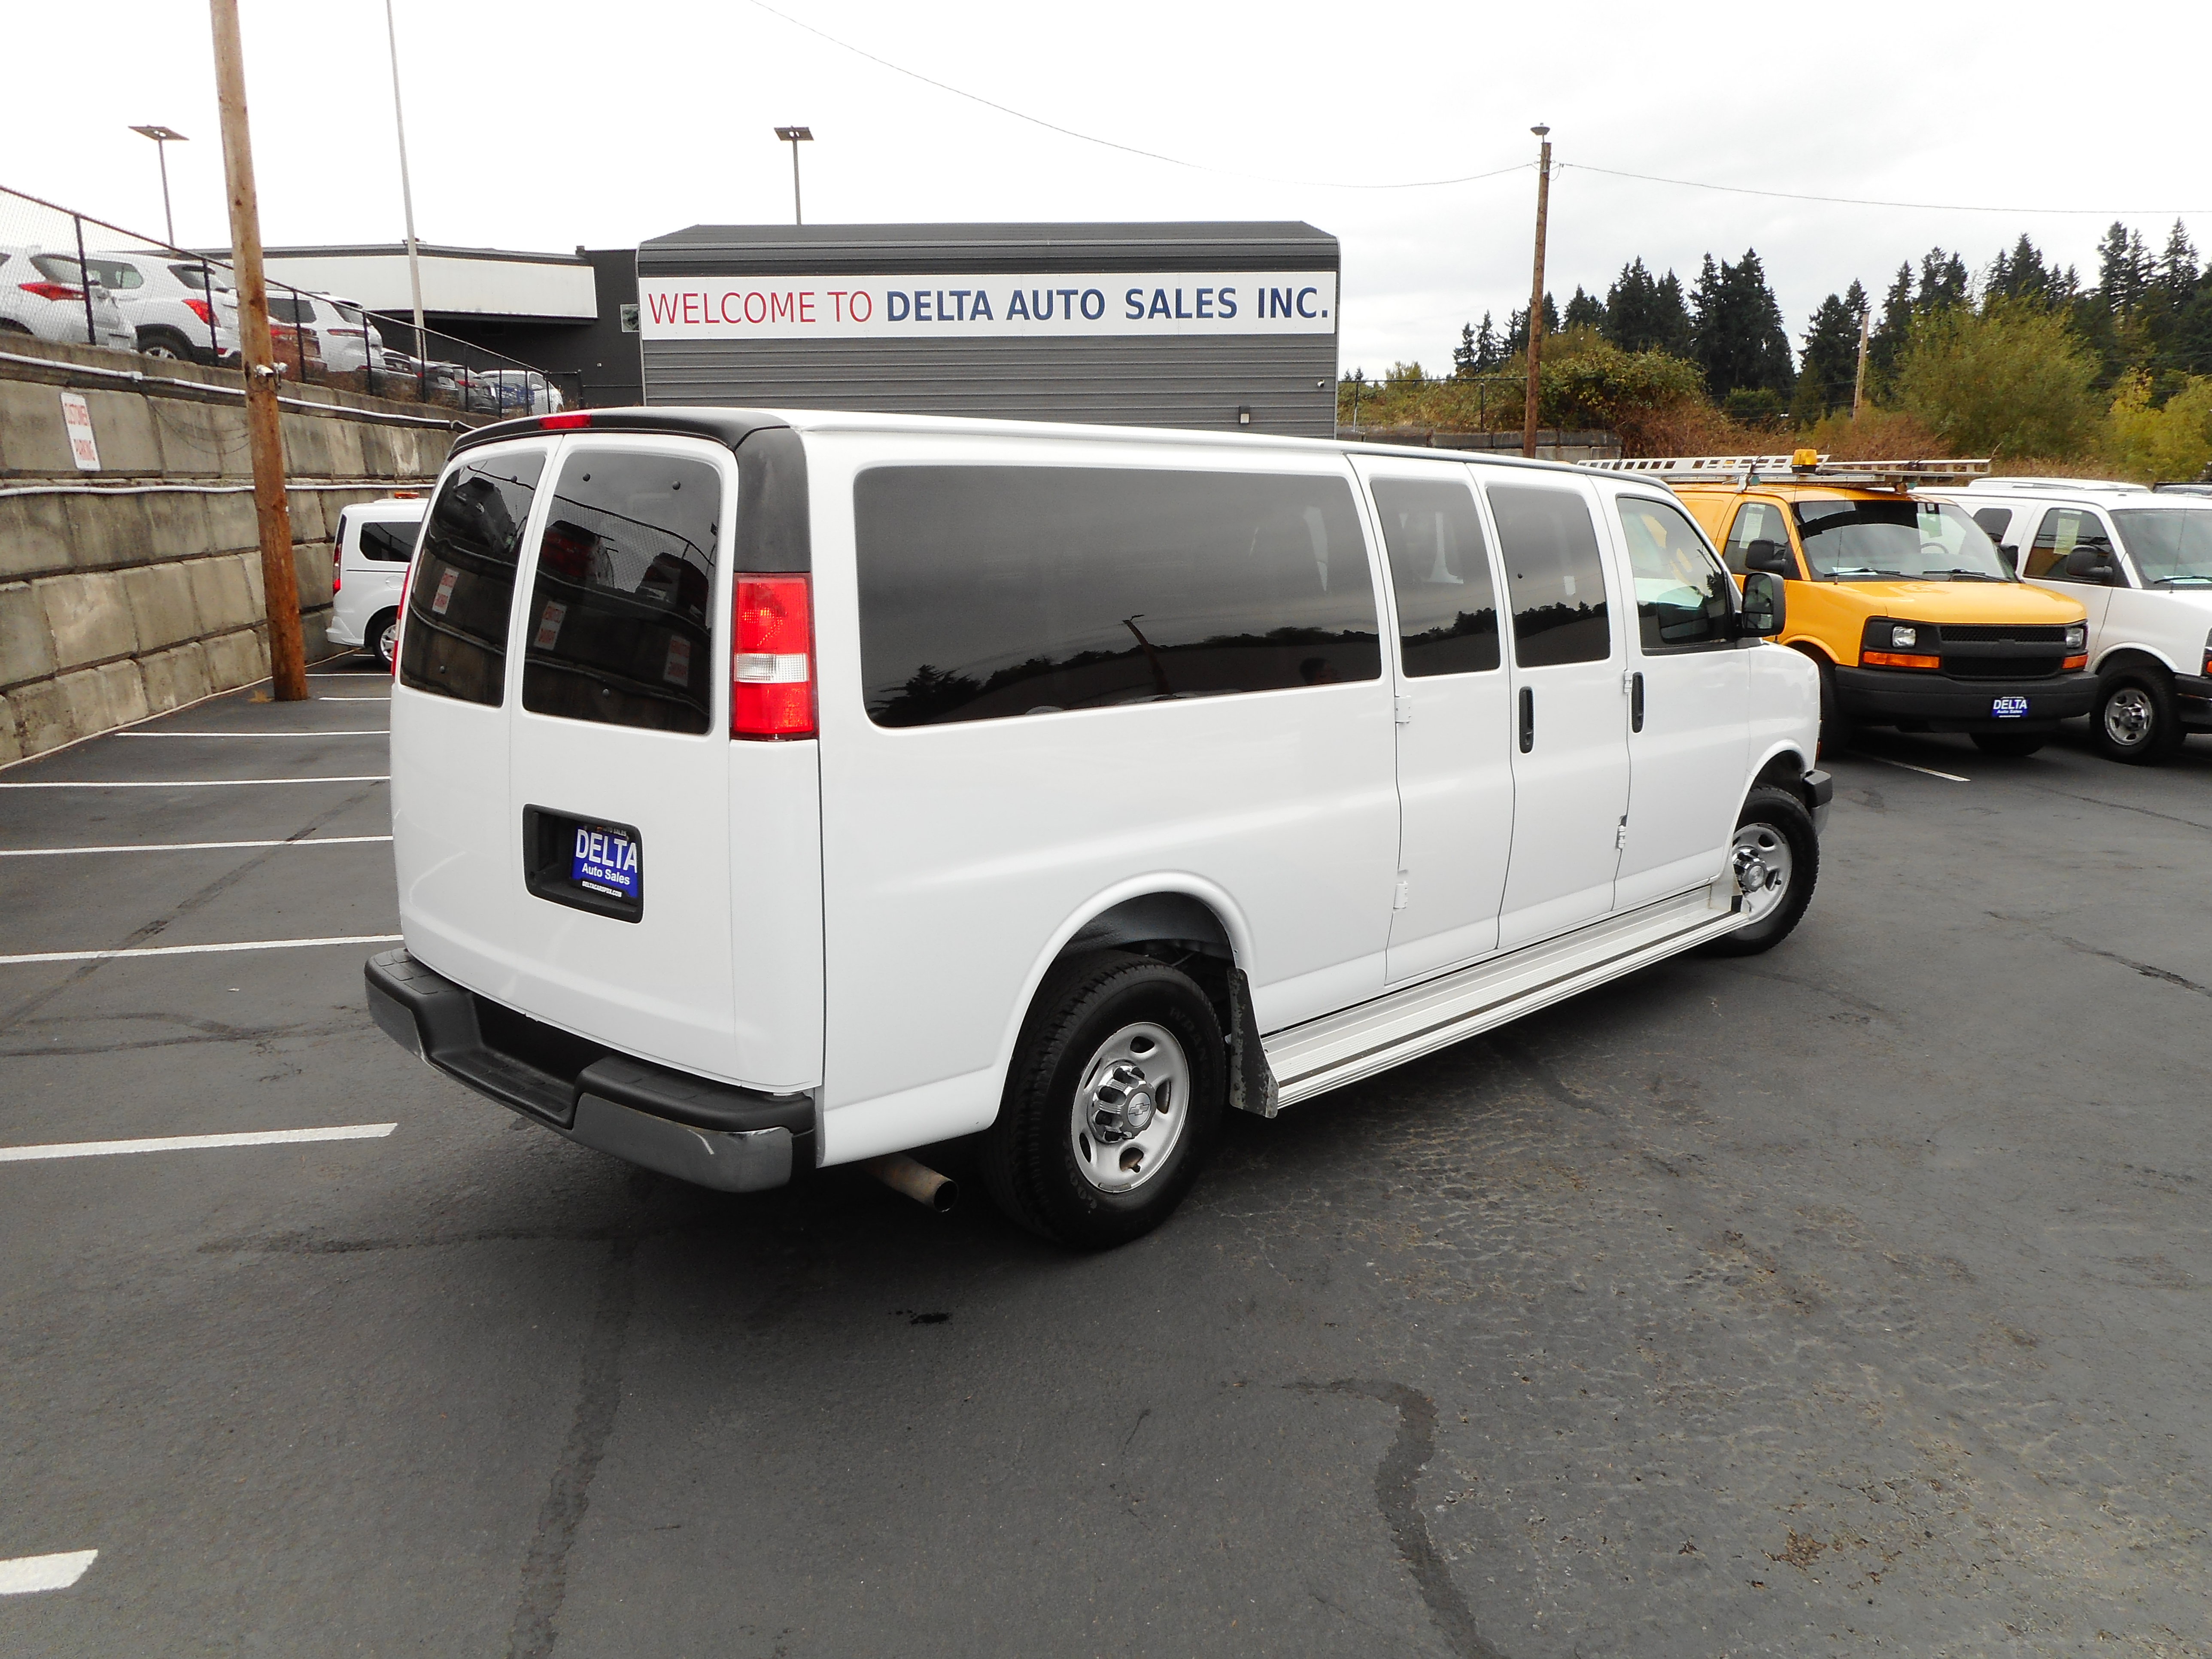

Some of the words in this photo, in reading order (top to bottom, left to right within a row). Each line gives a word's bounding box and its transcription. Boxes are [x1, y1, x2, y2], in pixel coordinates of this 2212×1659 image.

[648, 291, 816, 324] WELCOME
[828, 291, 872, 322] TO
[888, 290, 993, 320] DELTA
[1009, 289, 1105, 319] AUTO
[1127, 288, 1237, 318] SALES
[1259, 286, 1328, 317] INC.
[1993, 699, 2027, 709] DELTA
[576, 829, 637, 873] DELTA
[582, 863, 602, 877] Auto
[605, 869, 630, 884] Sales
